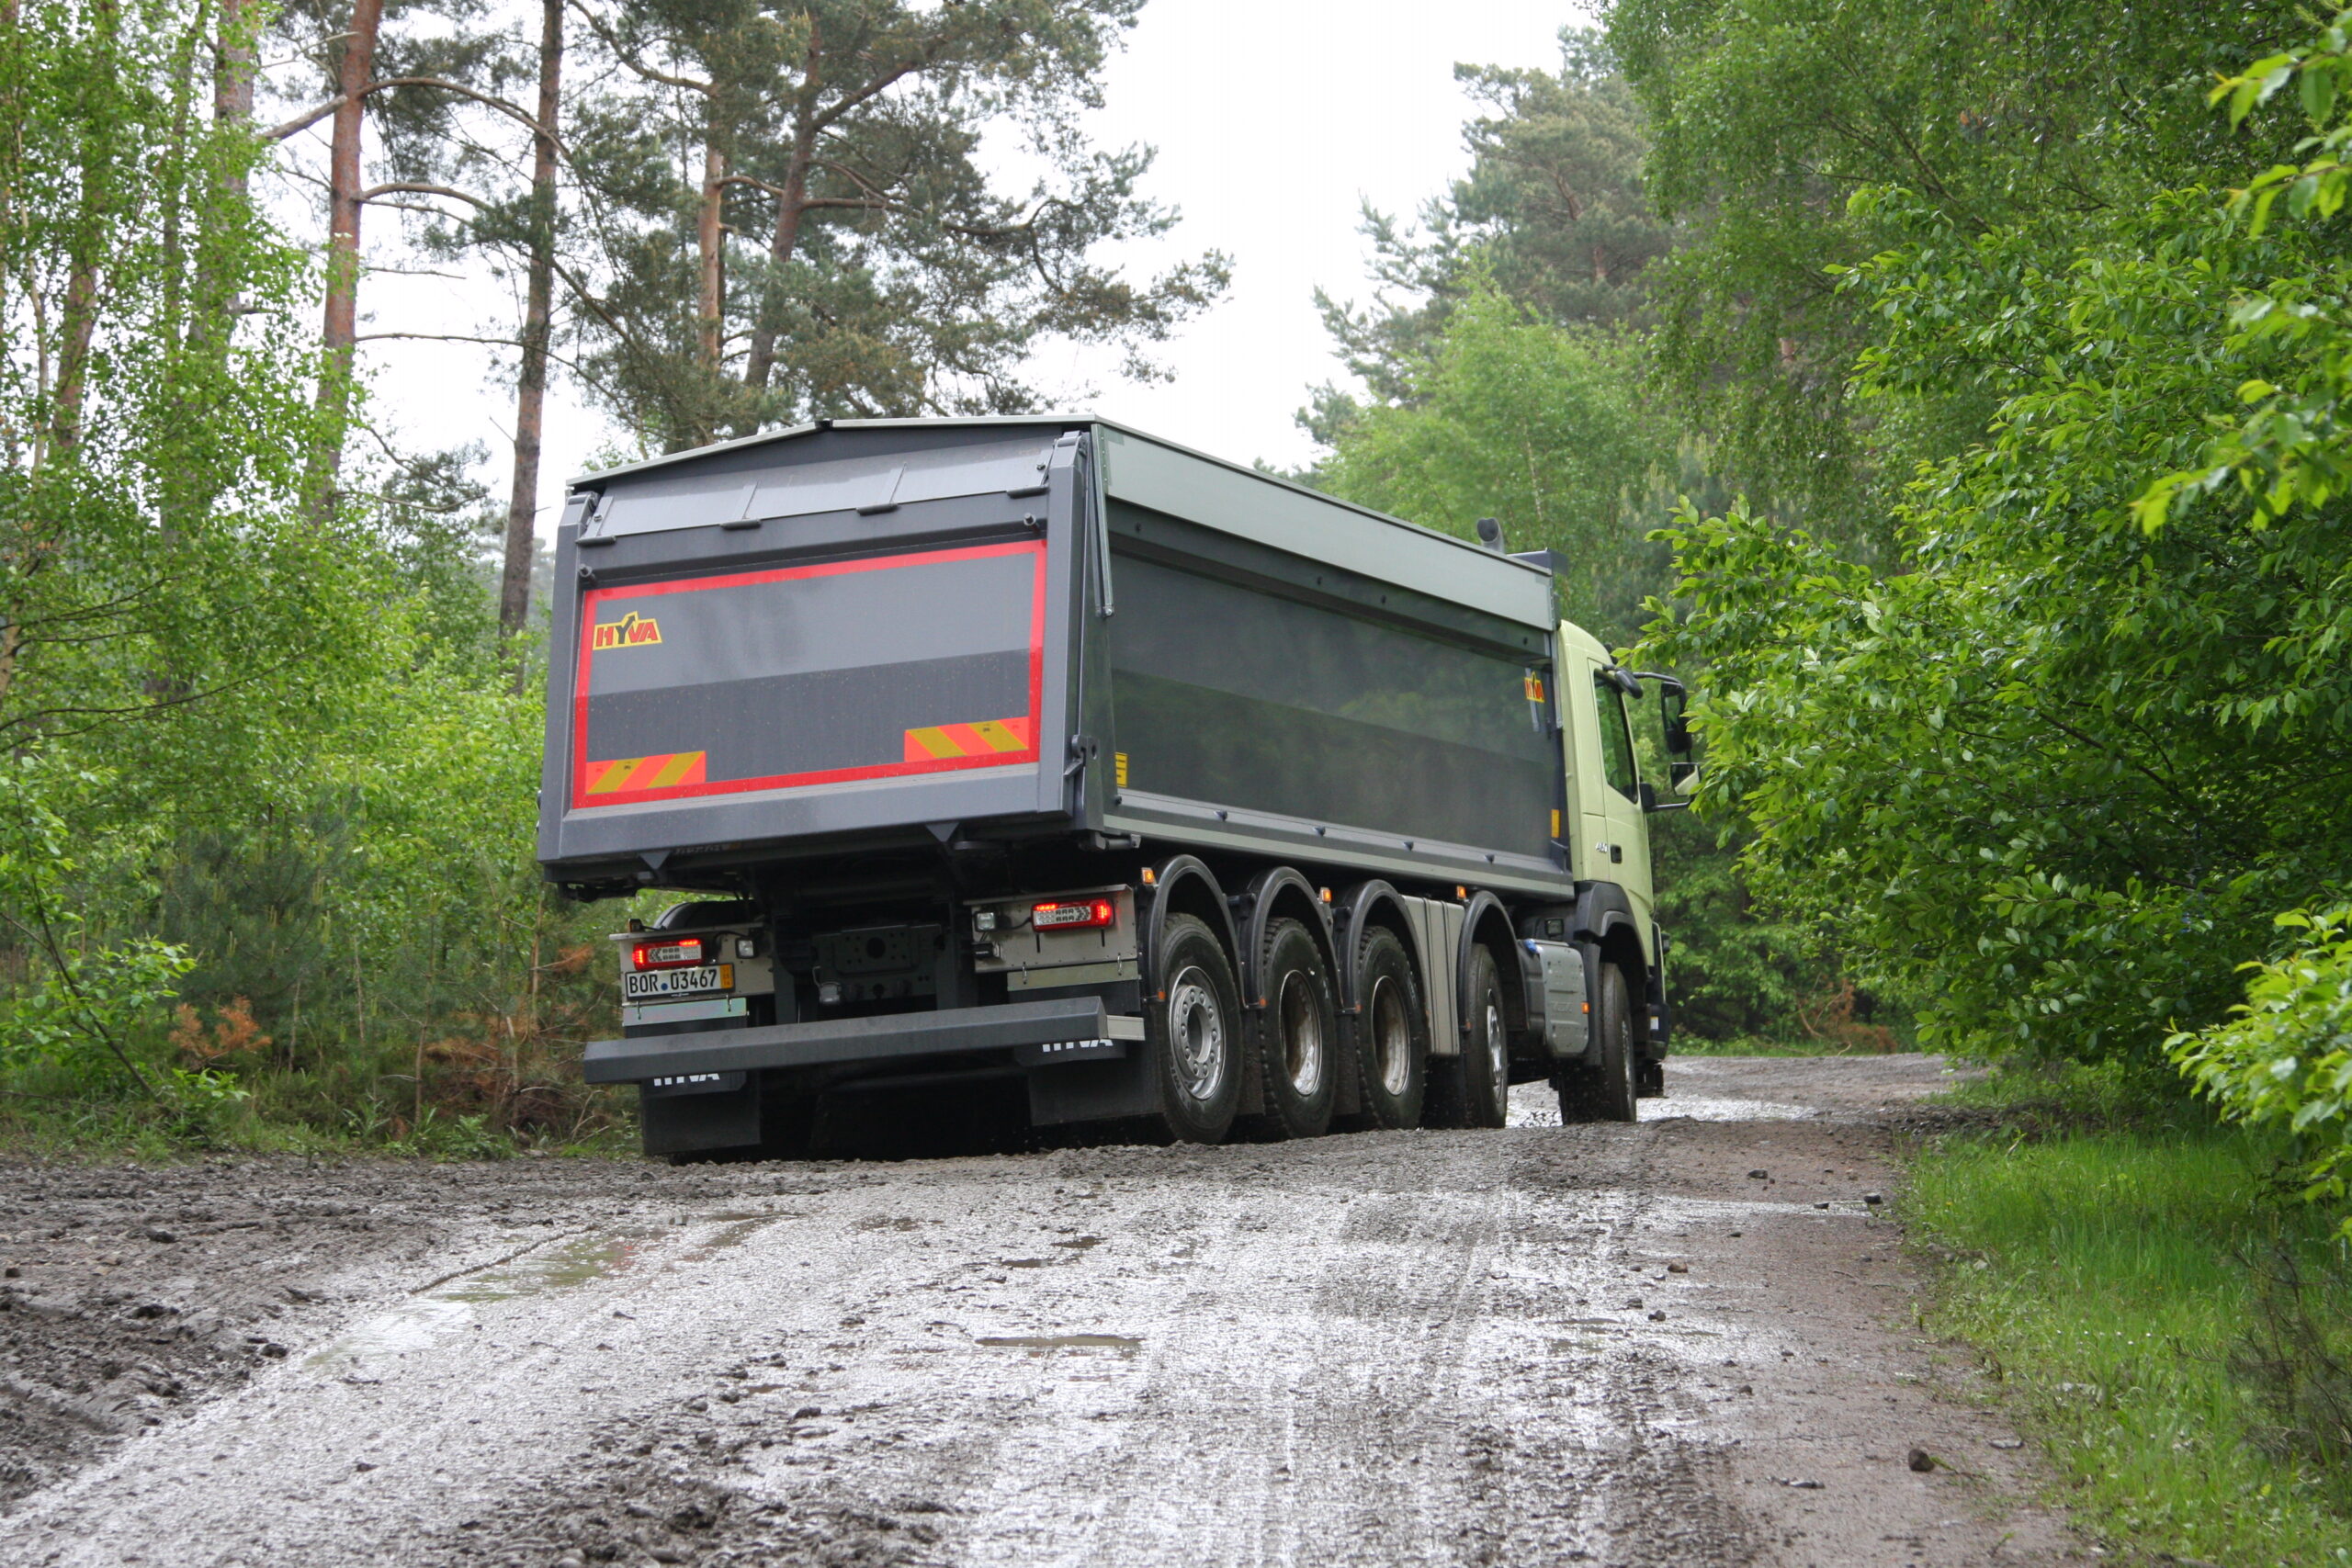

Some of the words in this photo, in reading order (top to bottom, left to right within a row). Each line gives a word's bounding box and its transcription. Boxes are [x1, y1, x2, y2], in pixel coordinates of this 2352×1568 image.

[595, 615, 659, 648] HYVA
[628, 974, 658, 994] BOR
[670, 968, 718, 990] 03467
